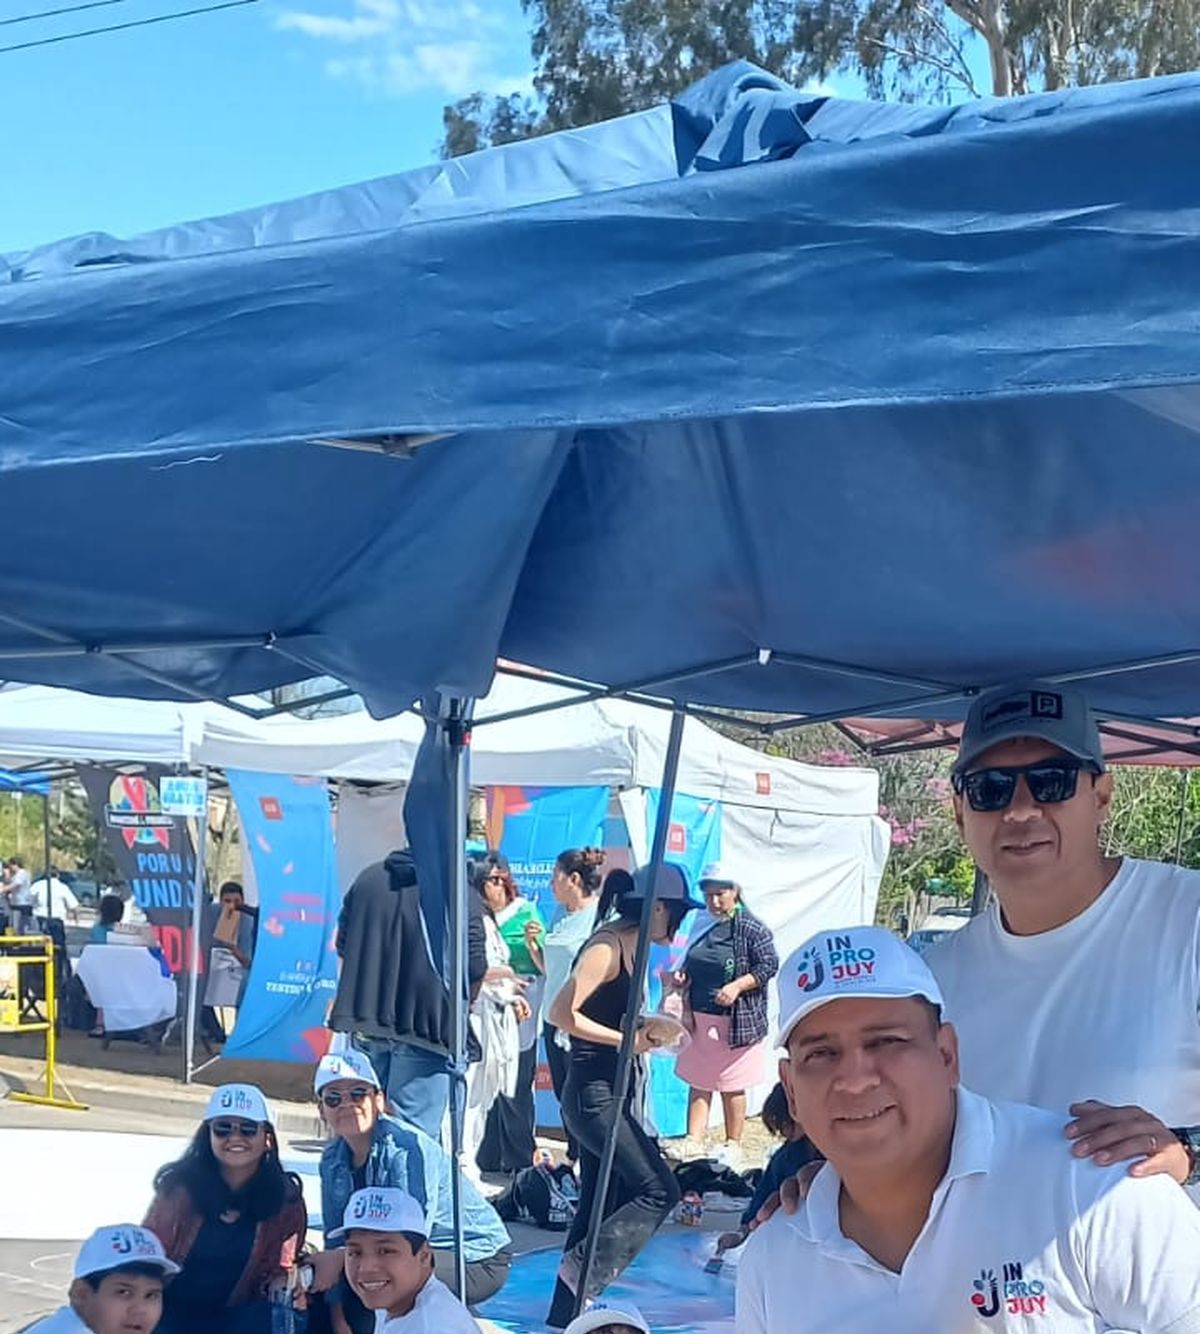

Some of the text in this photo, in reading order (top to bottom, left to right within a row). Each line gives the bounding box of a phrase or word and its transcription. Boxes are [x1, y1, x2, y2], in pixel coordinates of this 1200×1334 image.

[137, 852, 169, 873] POR
[826, 935, 852, 952] IN
[829, 947, 875, 966] PRO
[831, 961, 875, 979] JUY
[1003, 1262, 1023, 1281] IN
[1004, 1280, 1045, 1298] PRO
[1006, 1295, 1046, 1314] JUY
